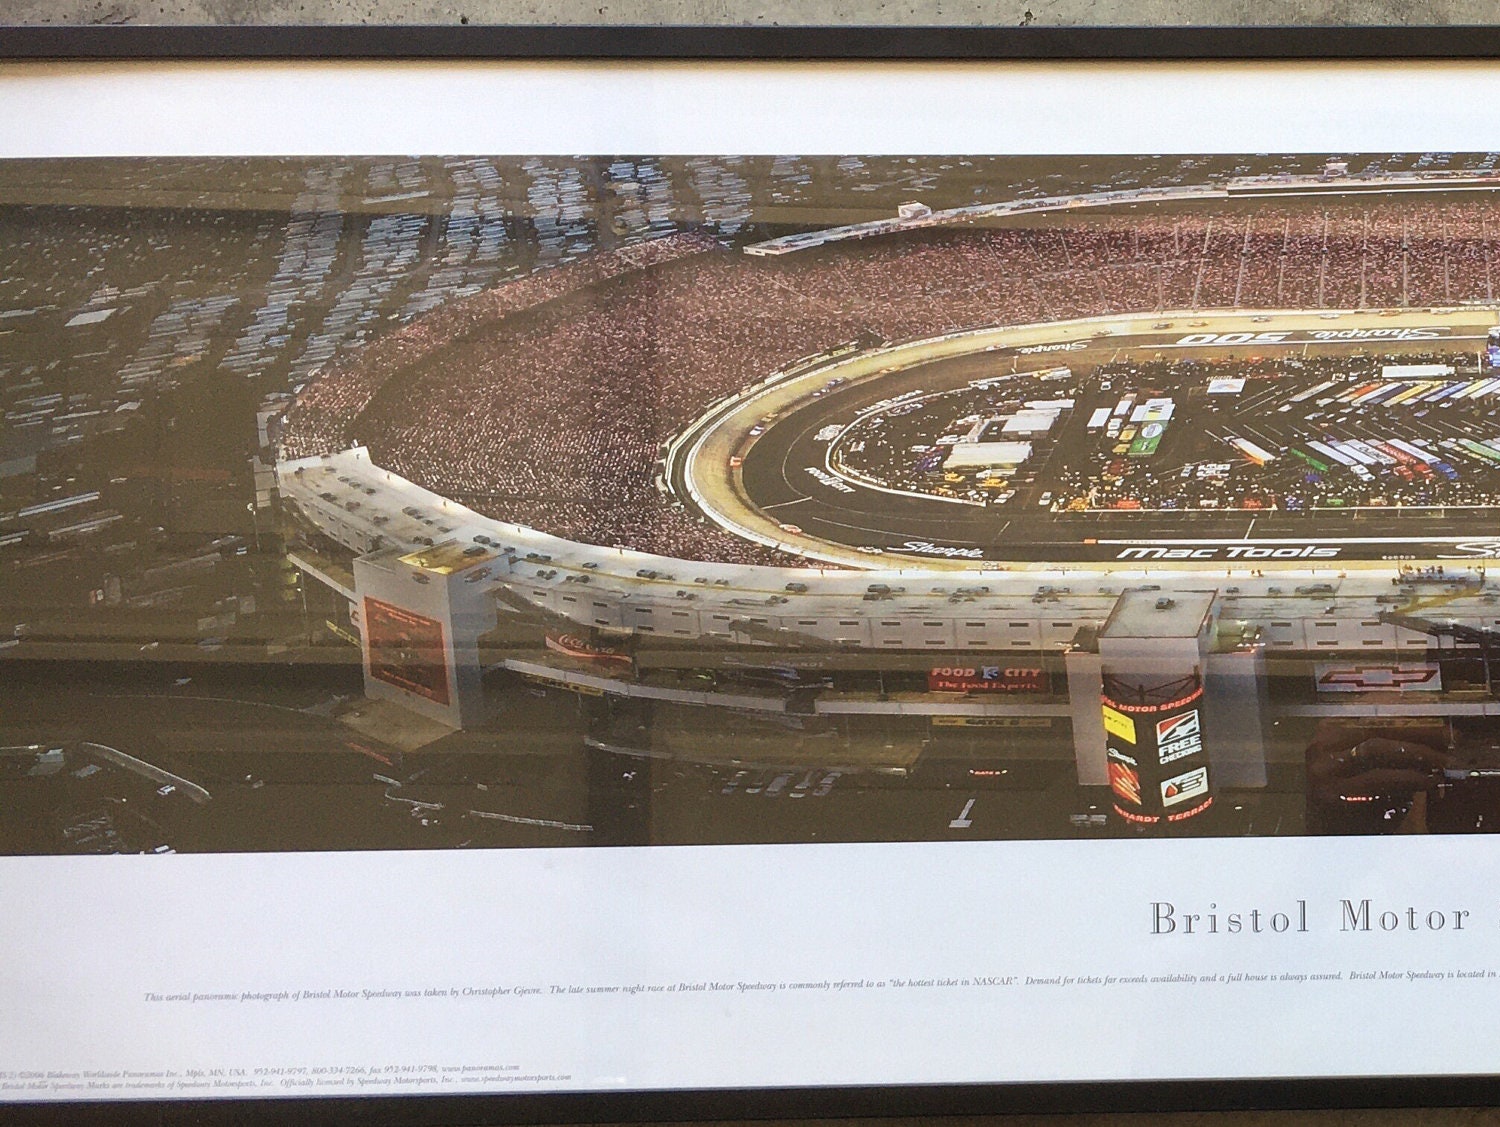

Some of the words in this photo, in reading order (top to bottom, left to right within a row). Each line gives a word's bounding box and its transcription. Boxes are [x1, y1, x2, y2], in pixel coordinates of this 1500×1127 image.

[1175, 331, 1292, 345] 500
[1117, 547, 1218, 559] Mac
[1226, 545, 1342, 558] Tools
[931, 667, 976, 677] FOOD
[1004, 668, 1042, 677] CITY
[1118, 704, 1157, 713] MOTOR
[1159, 734, 1202, 757] FREE
[1149, 898, 1312, 935] Bristol
[1339, 897, 1472, 932] Motor
[144, 991, 164, 1002] This
[165, 991, 191, 1001] aerial
[192, 991, 240, 1002] panoramic
[240, 990, 289, 1001] photograph
[291, 989, 301, 1000] of
[302, 989, 331, 999] Bristol
[332, 989, 360, 998] Motor
[361, 988, 402, 999] Speedway
[404, 990, 422, 999] was
[423, 987, 447, 998] taken
[449, 987, 459, 998] by
[462, 986, 511, 998] Christopher
[549, 984, 566, 994] The
[568, 984, 584, 994] late
[622, 983, 645, 995] night
[666, 983, 676, 992] at
[678, 981, 707, 992] Bristol
[708, 981, 735, 991] Motor
[736, 981, 776, 993] Speedway
[779, 981, 786, 989] is
[788, 979, 831, 991] commonly
[833, 978, 864, 991] referred
[865, 979, 875, 988] to
[907, 978, 935, 987] hottest
[936, 977, 959, 986] ticket
[960, 977, 970, 986] in
[1024, 975, 1061, 985] Demand
[1061, 975, 1075, 987] for
[1077, 975, 1102, 984] tickets
[1102, 975, 1117, 986] far
[1118, 974, 1148, 984] exceeds
[1150, 973, 1197, 985] availability
[1199, 973, 1217, 982] and
[1225, 973, 1243, 984] full
[1244, 973, 1268, 981] house
[1279, 972, 1308, 984] always
[1349, 971, 1377, 980] Bristol
[1378, 971, 1404, 979] Motor
[1405, 970, 1445, 982] Speedway
[1447, 970, 1454, 978] is
[1456, 969, 1485, 978] located
